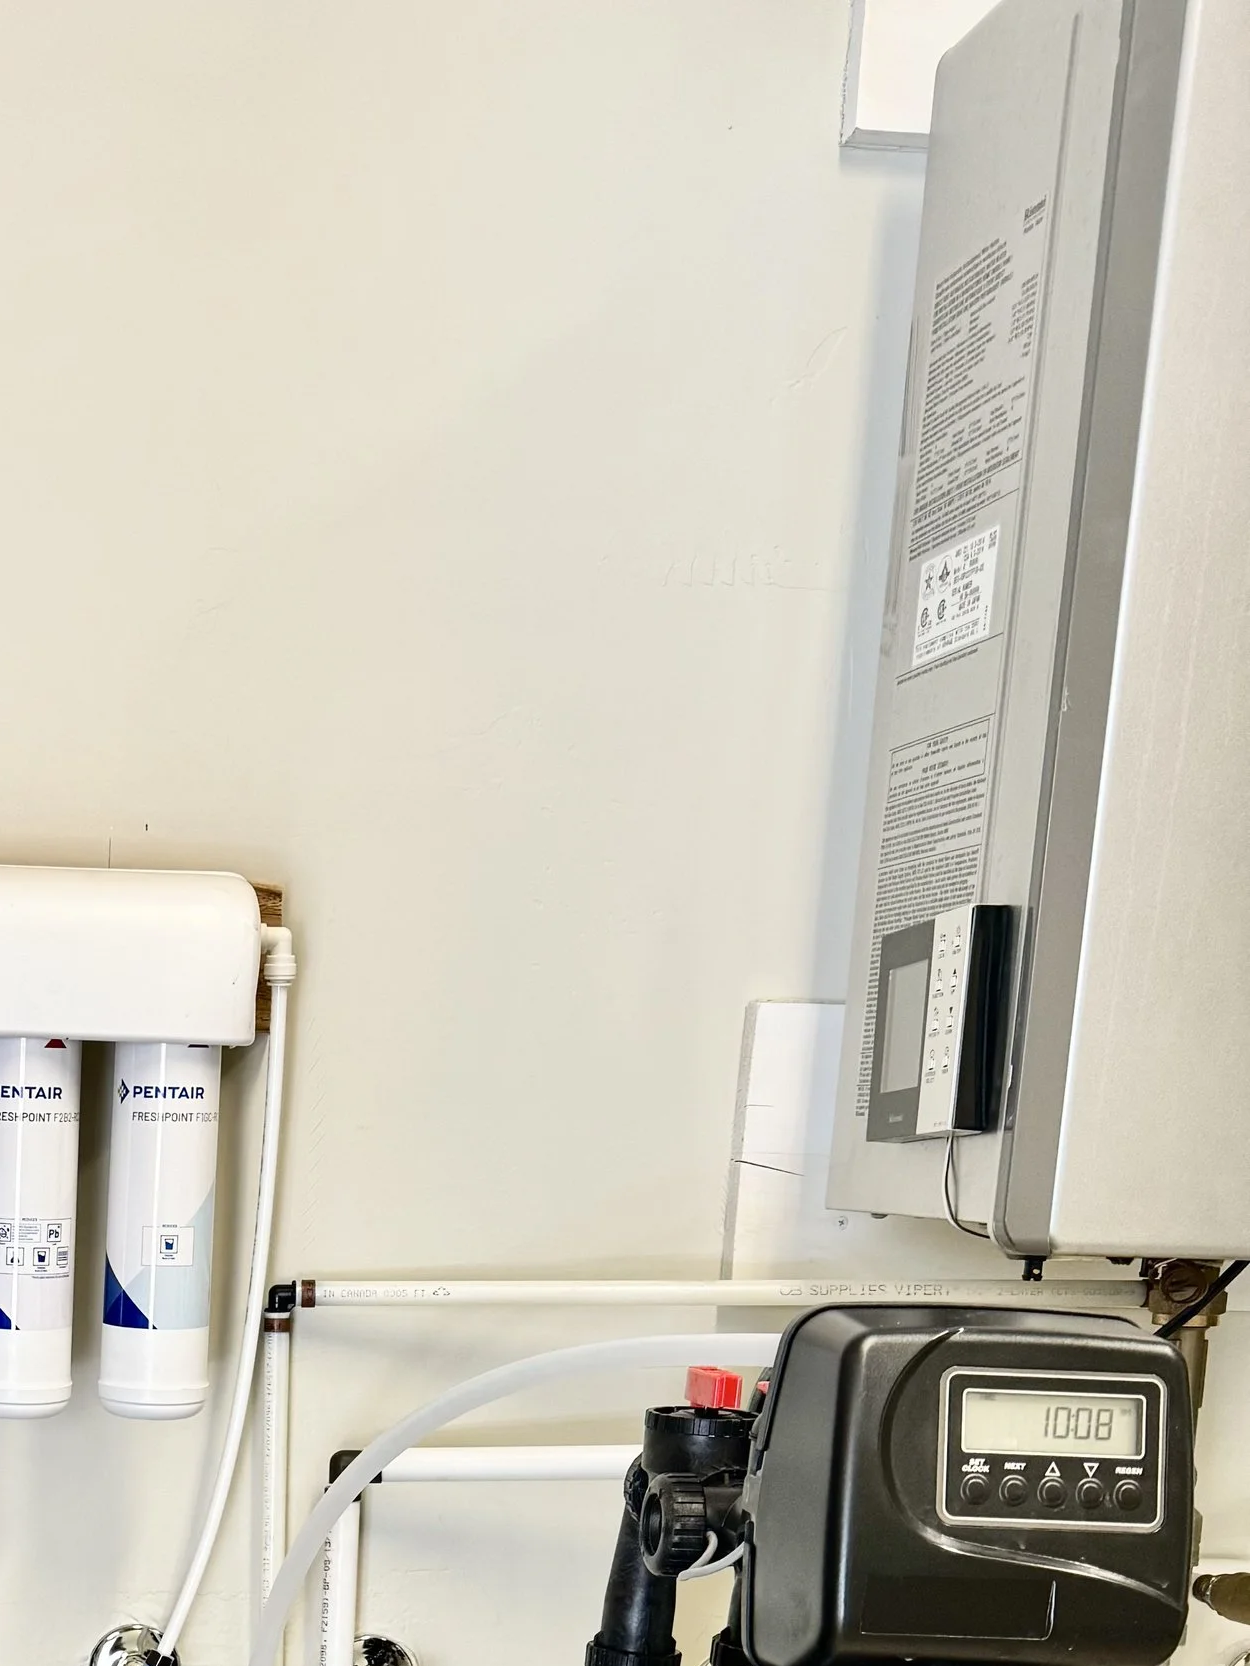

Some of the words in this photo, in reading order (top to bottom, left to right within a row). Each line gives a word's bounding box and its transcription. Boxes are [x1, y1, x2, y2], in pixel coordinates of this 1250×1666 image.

[132, 1085, 205, 1099] PENTAIR
[132, 1111, 194, 1122] FRESHPOINT
[48, 1229, 60, 1239] Pb
[341, 1288, 378, 1298] CANADA
[809, 1283, 888, 1296] SUPPLIES
[1043, 1406, 1114, 1441] 10:08
[968, 1457, 987, 1466] SET
[1003, 1462, 1027, 1471] NEXT
[961, 1465, 991, 1473] CLOCK
[1114, 1466, 1143, 1475] REGEN
